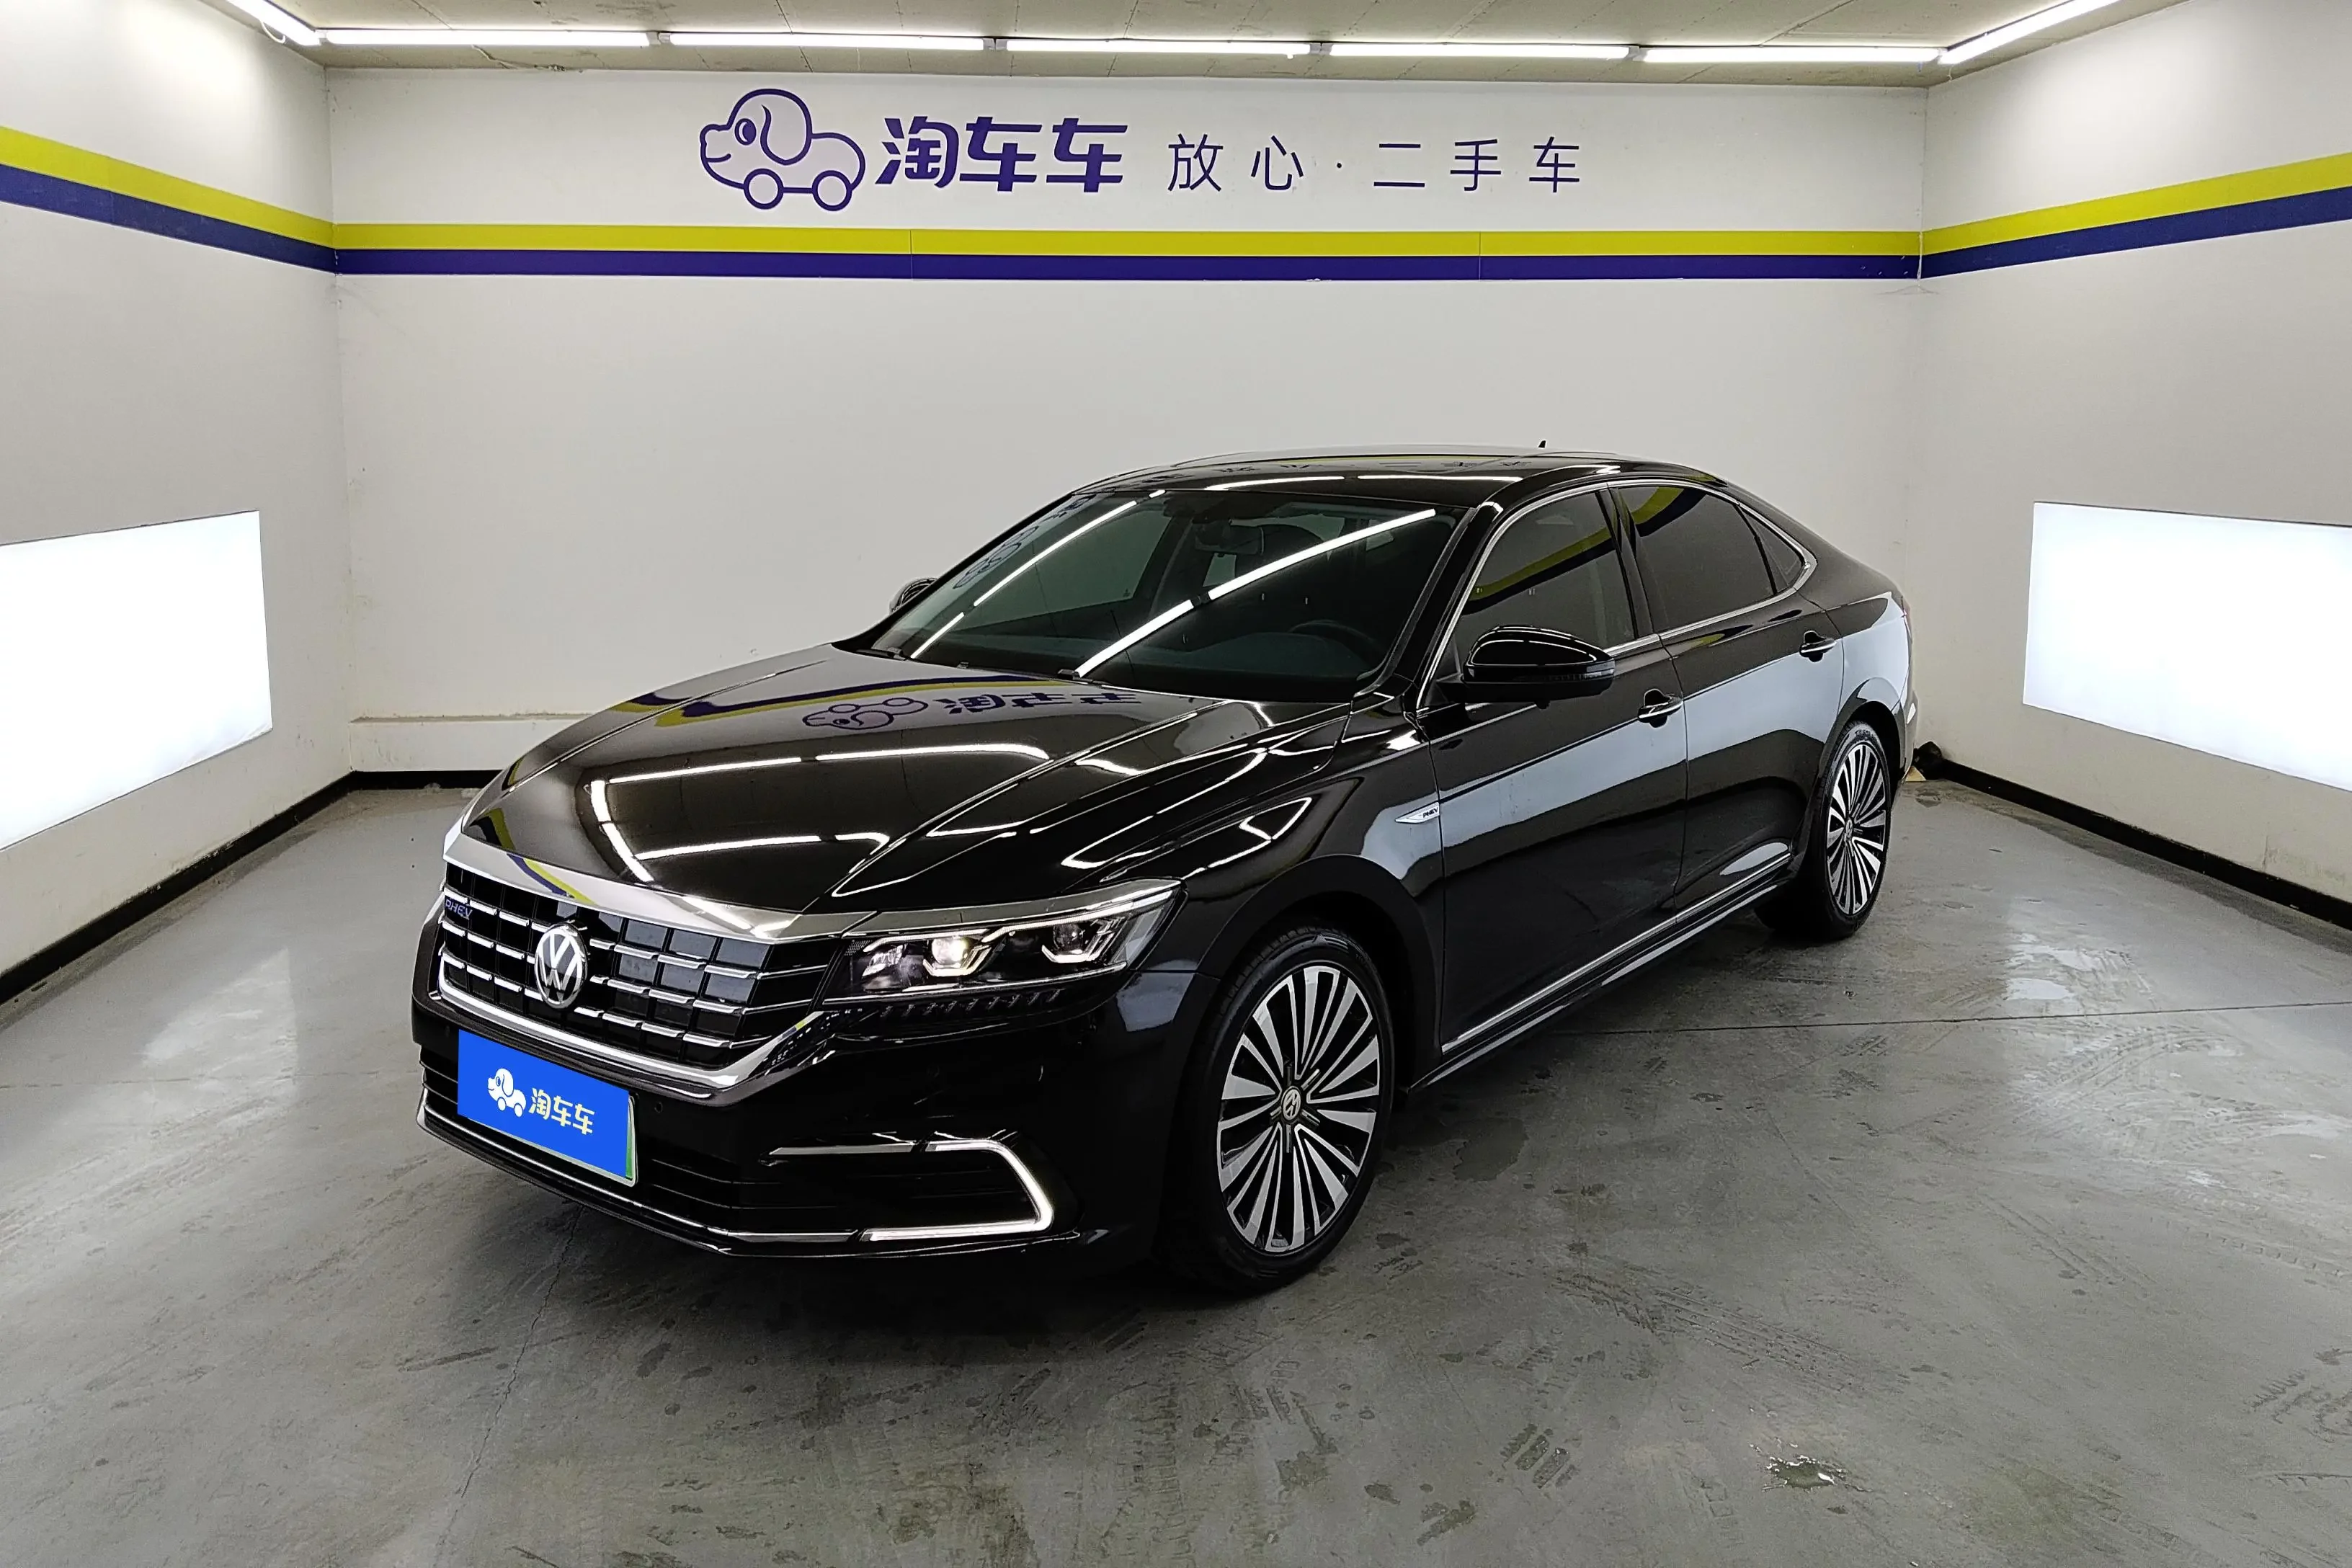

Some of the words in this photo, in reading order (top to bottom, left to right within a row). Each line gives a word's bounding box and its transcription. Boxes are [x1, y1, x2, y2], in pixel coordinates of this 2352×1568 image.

[874, 115, 1128, 193] 淘车车
[1423, 807, 1438, 818] PHEV
[445, 899, 473, 920] PHEV
